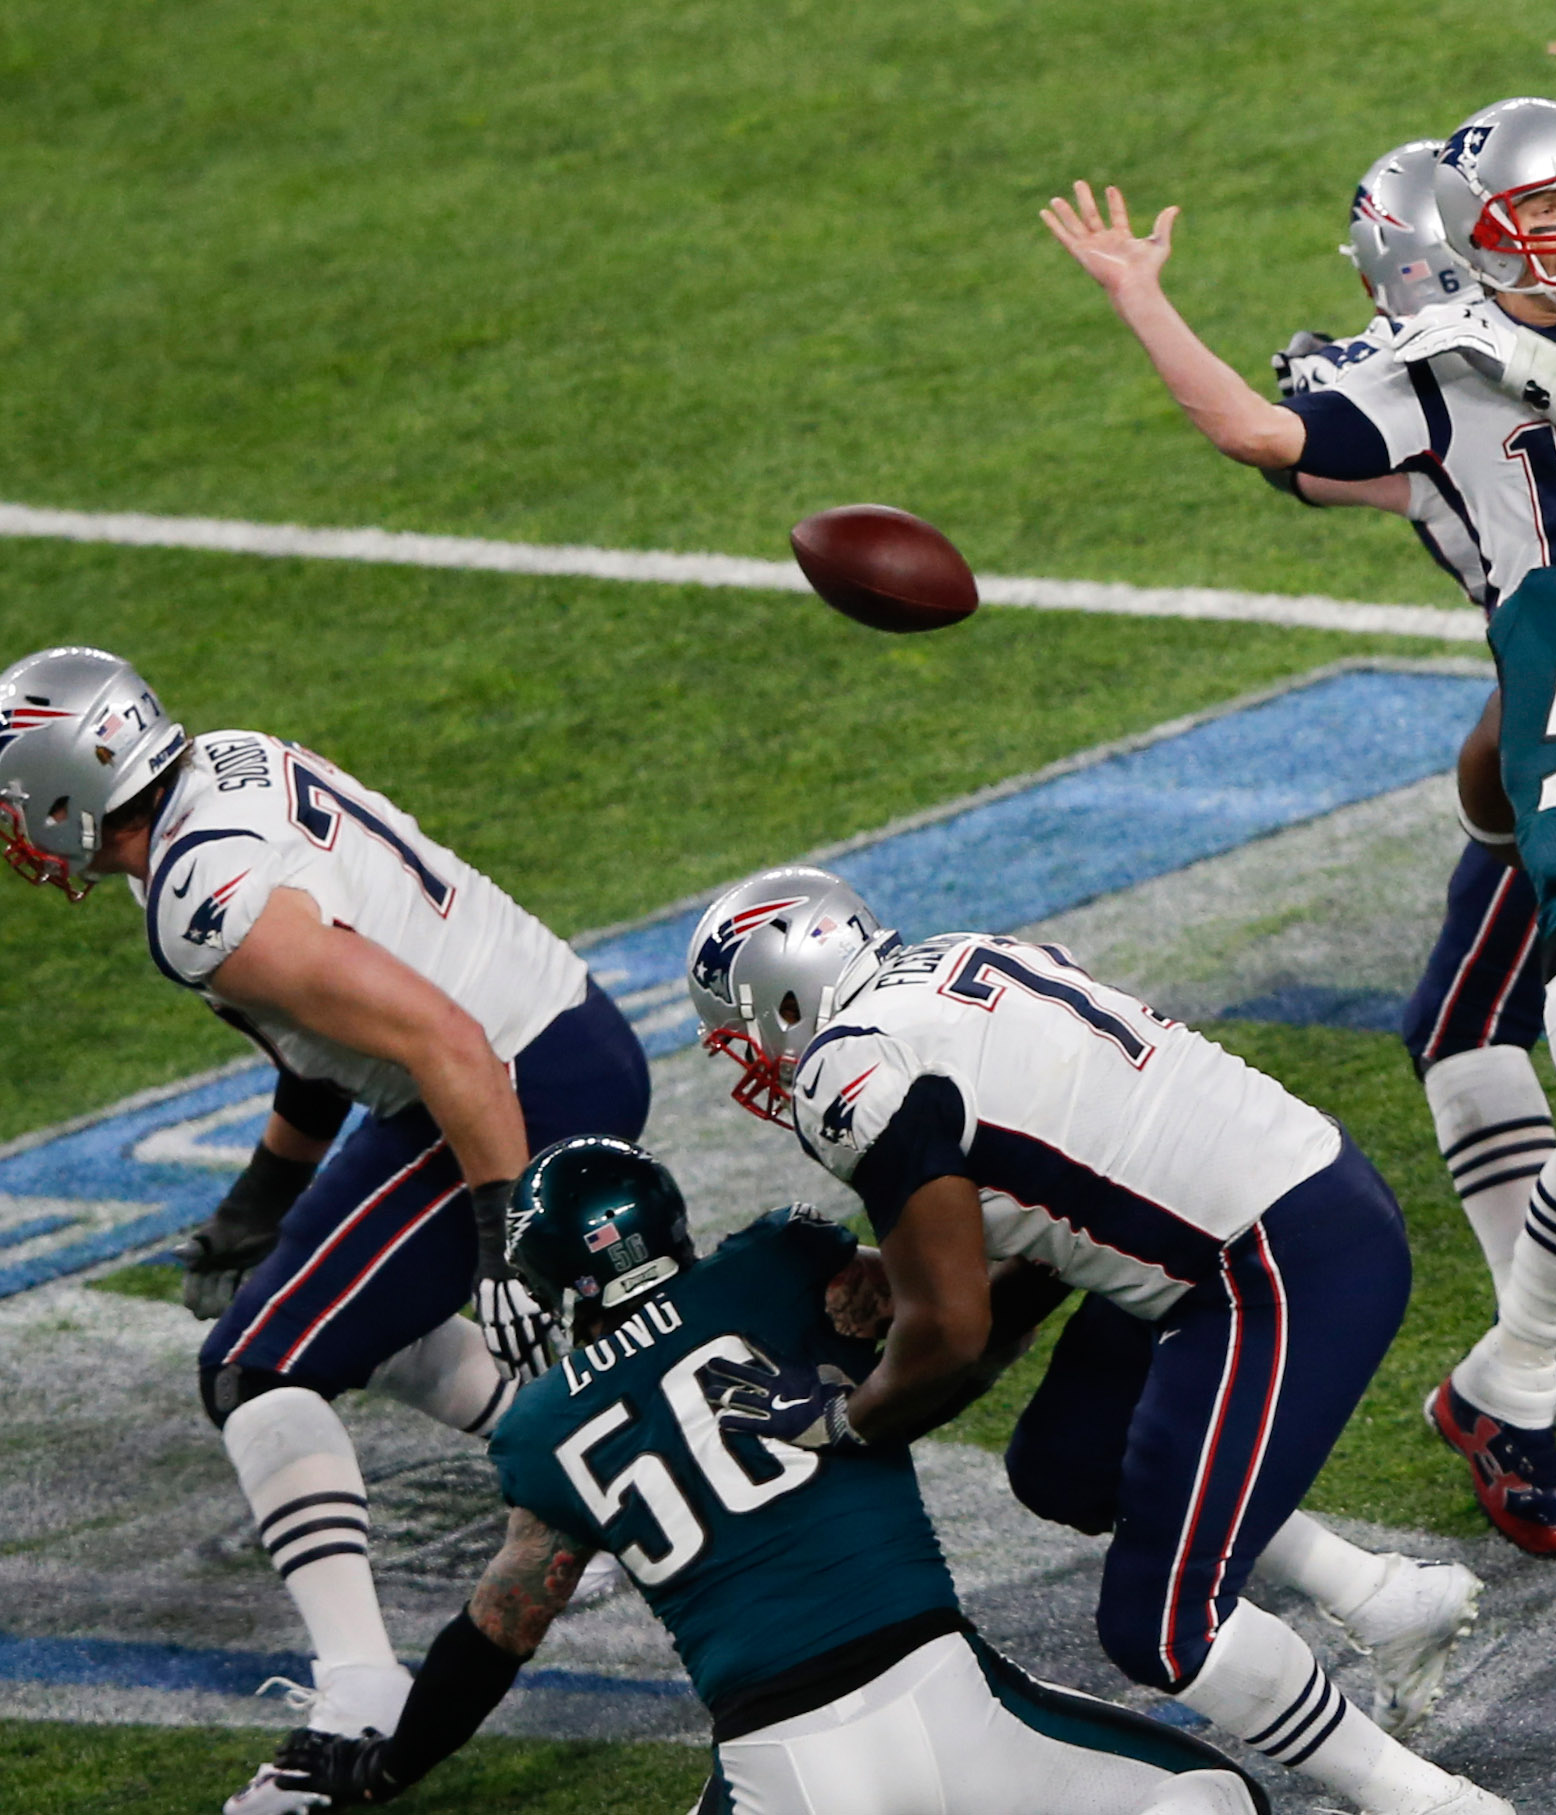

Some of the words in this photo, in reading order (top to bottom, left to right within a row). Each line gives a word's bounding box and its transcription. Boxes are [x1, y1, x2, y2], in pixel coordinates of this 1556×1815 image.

[123, 692, 160, 731] 77
[847, 915, 869, 942] 7
[607, 1233, 649, 1273] 56
[561, 1292, 683, 1397] LONG
[555, 1334, 820, 1587] 56
